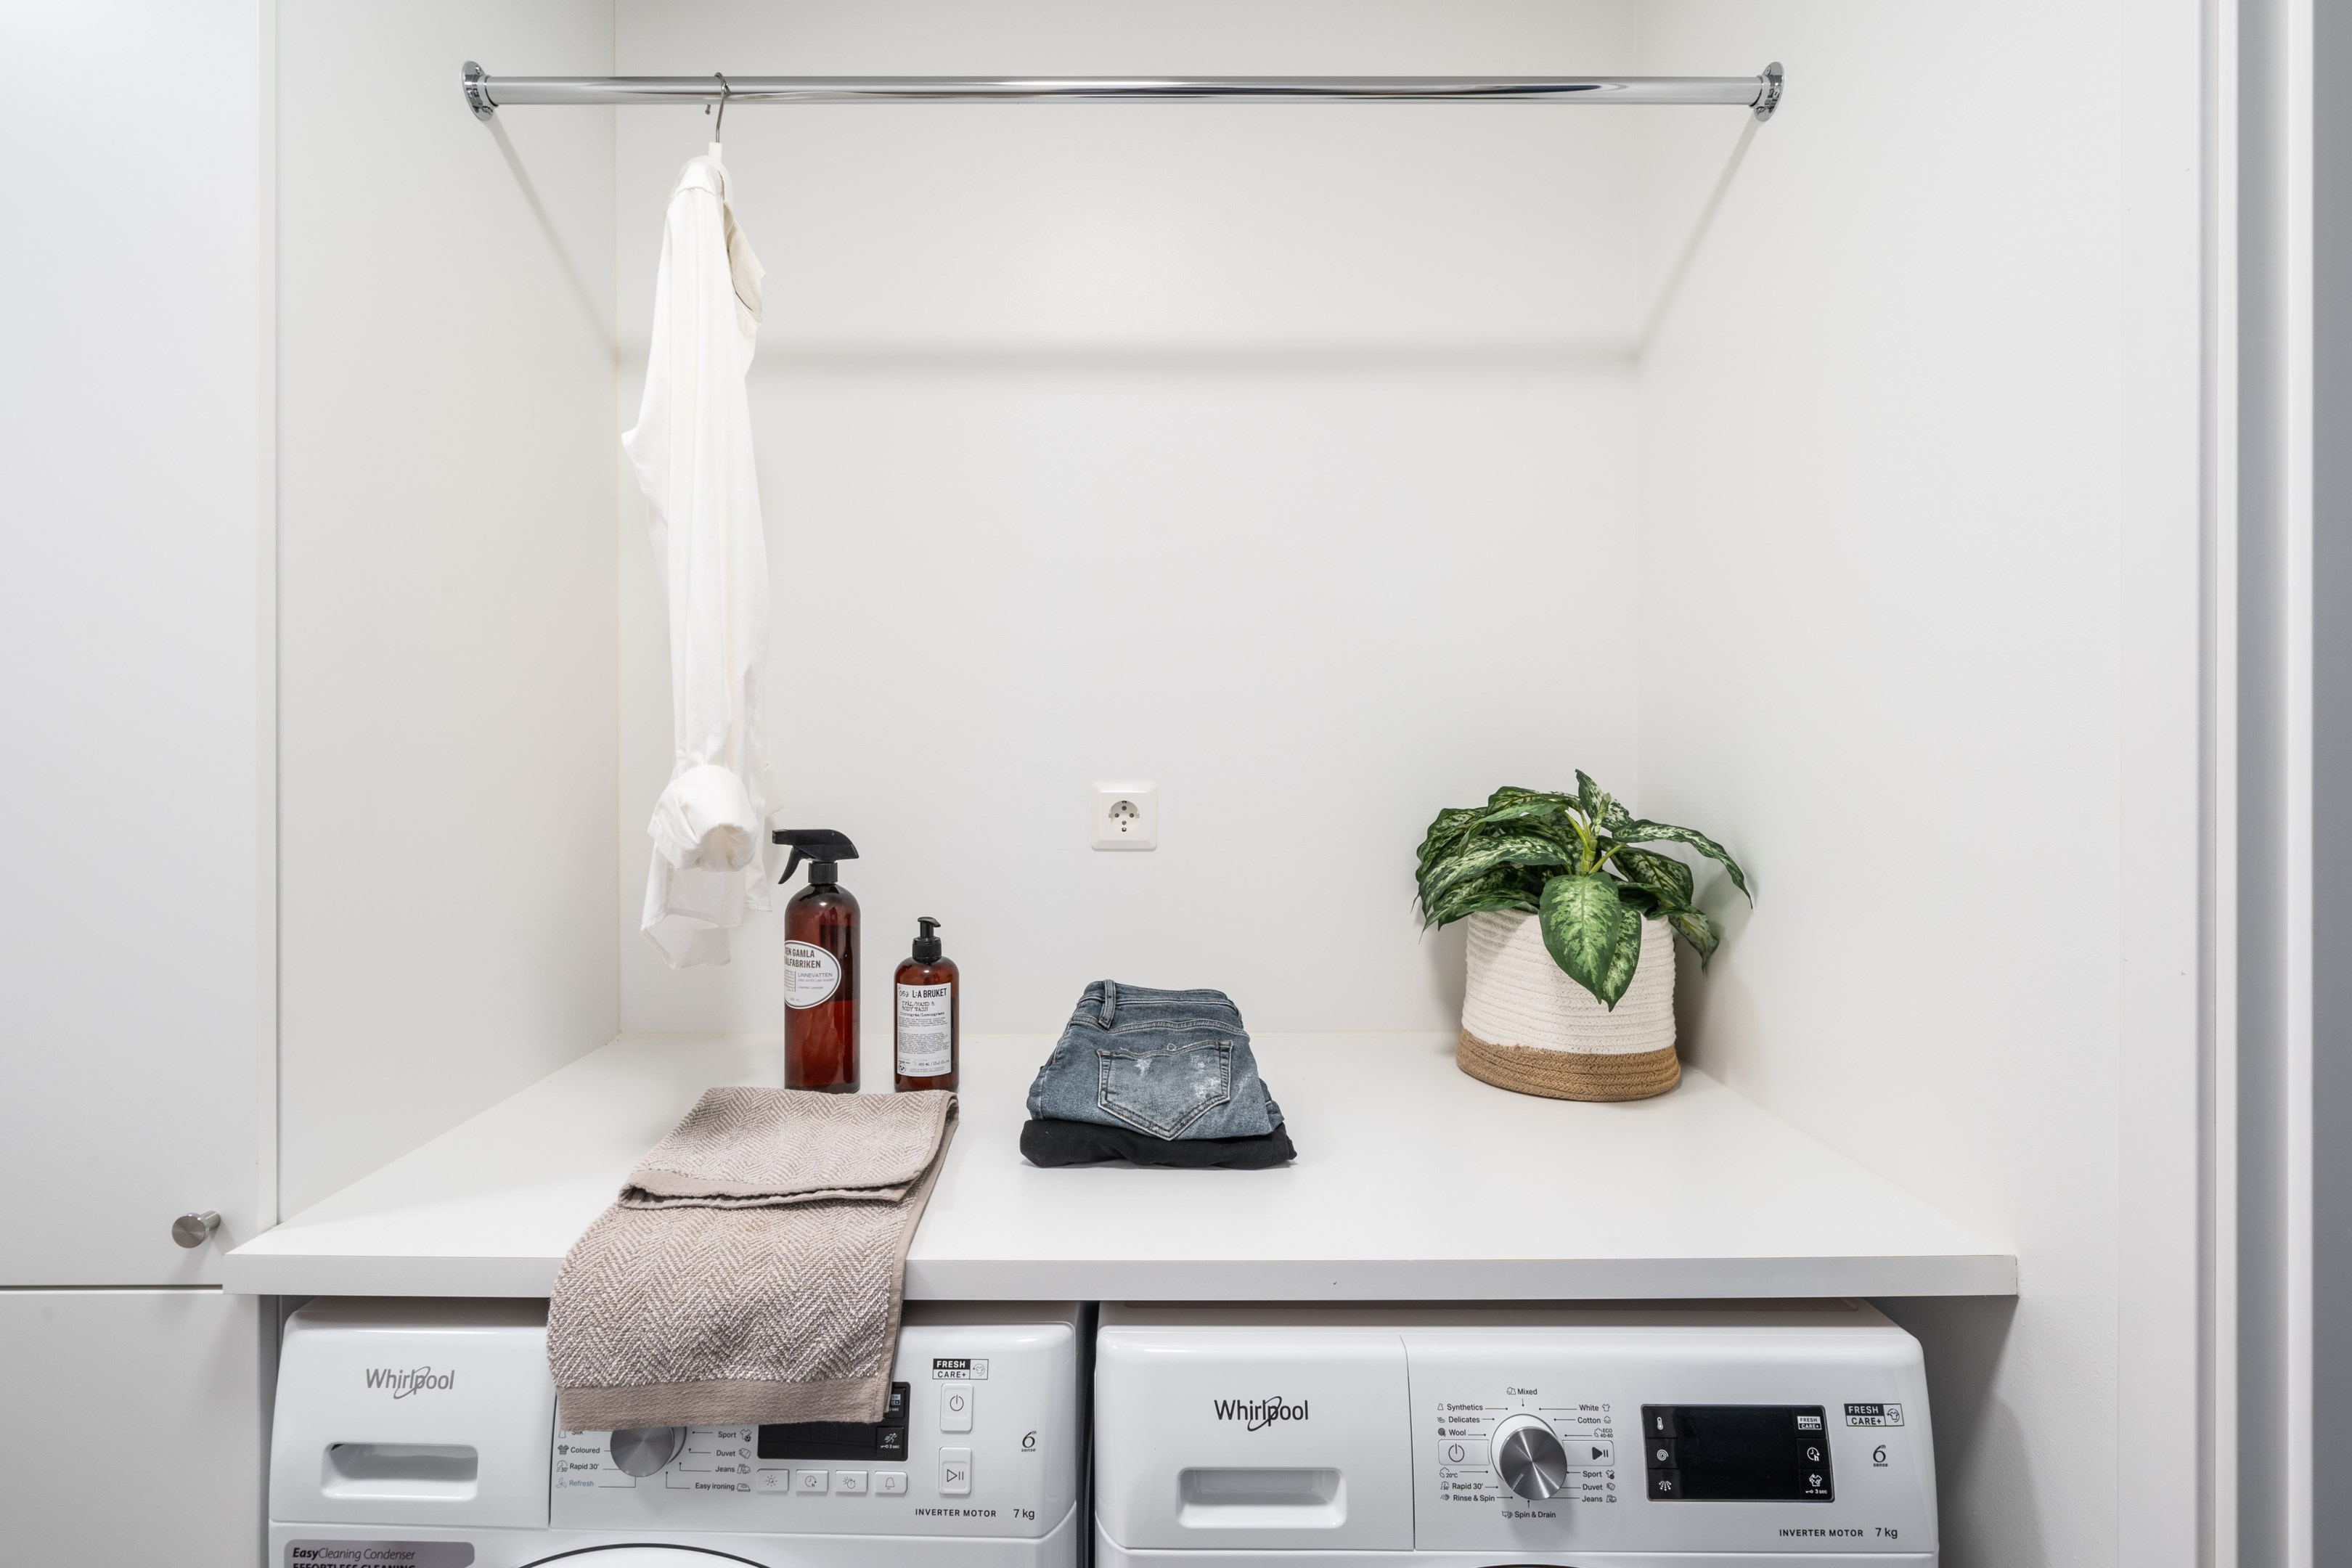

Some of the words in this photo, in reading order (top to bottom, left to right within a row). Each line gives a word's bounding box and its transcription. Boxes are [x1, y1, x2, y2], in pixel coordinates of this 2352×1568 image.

[792, 948, 815, 958] GAMLA
[923, 987, 947, 998] BRUKET
[366, 1365, 455, 1400] Whirlpool
[1447, 1403, 1484, 1412] Synthetics
[1848, 1405, 1879, 1414] FRESH
[1214, 1395, 1309, 1432] Whirlpool
[569, 1463, 588, 1471] Rapid
[1583, 1470, 1602, 1479] Sport
[695, 1482, 711, 1491] Easy
[711, 1483, 735, 1492] ironing
[1452, 1482, 1471, 1491] Rapid
[1013, 1508, 1019, 1518] 7
[1022, 1508, 1035, 1521] kg
[1875, 1527, 1882, 1537] 7
[1885, 1527, 1898, 1539] kg
[364, 1548, 415, 1560] Condenser
